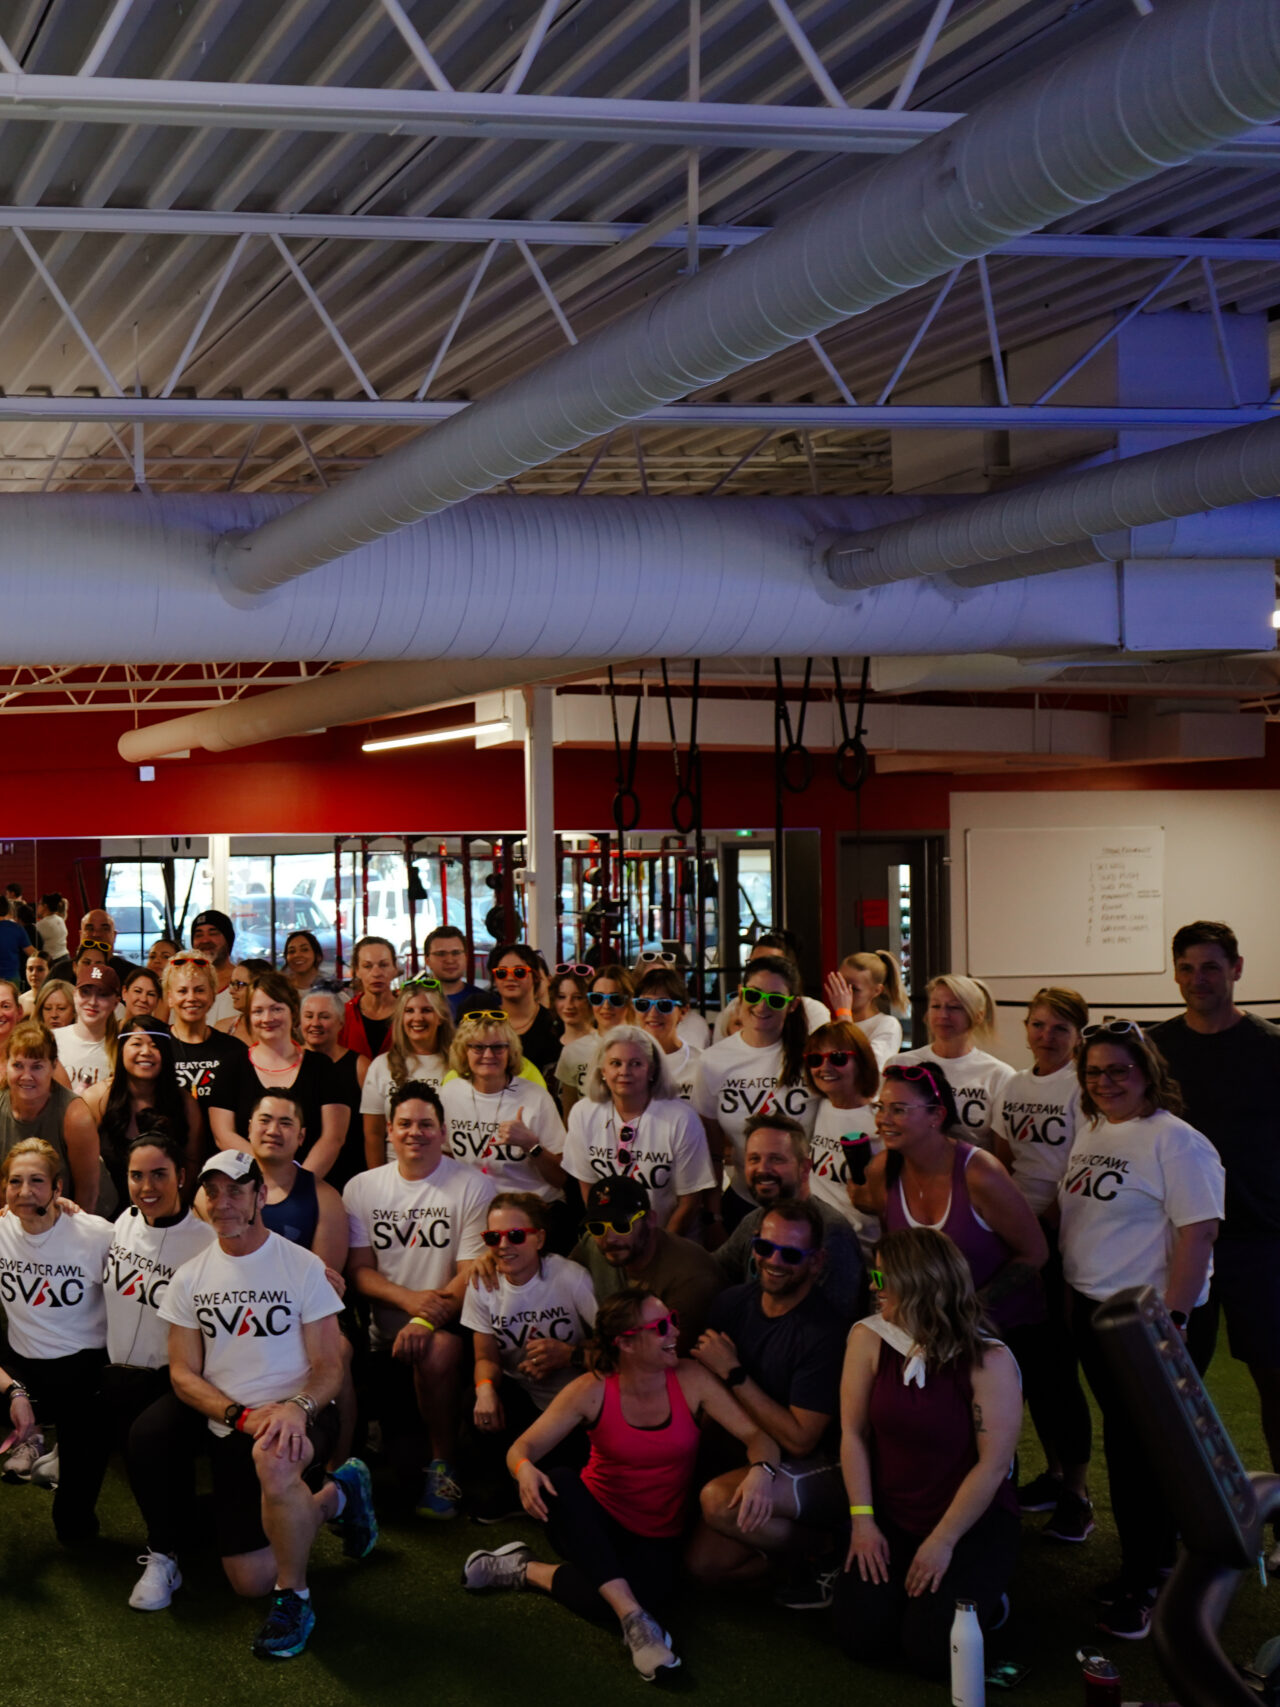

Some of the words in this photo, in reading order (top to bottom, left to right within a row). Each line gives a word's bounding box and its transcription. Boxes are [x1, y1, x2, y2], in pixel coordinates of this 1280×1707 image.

[1002, 1112, 1067, 1145] VAC
[373, 1219, 450, 1250] SVAC
[0, 1257, 85, 1278] SWEATCRAWL
[1, 1271, 85, 1308] SVAC
[193, 1290, 292, 1307] SWEATCRAWL
[197, 1305, 291, 1338] SVAC
